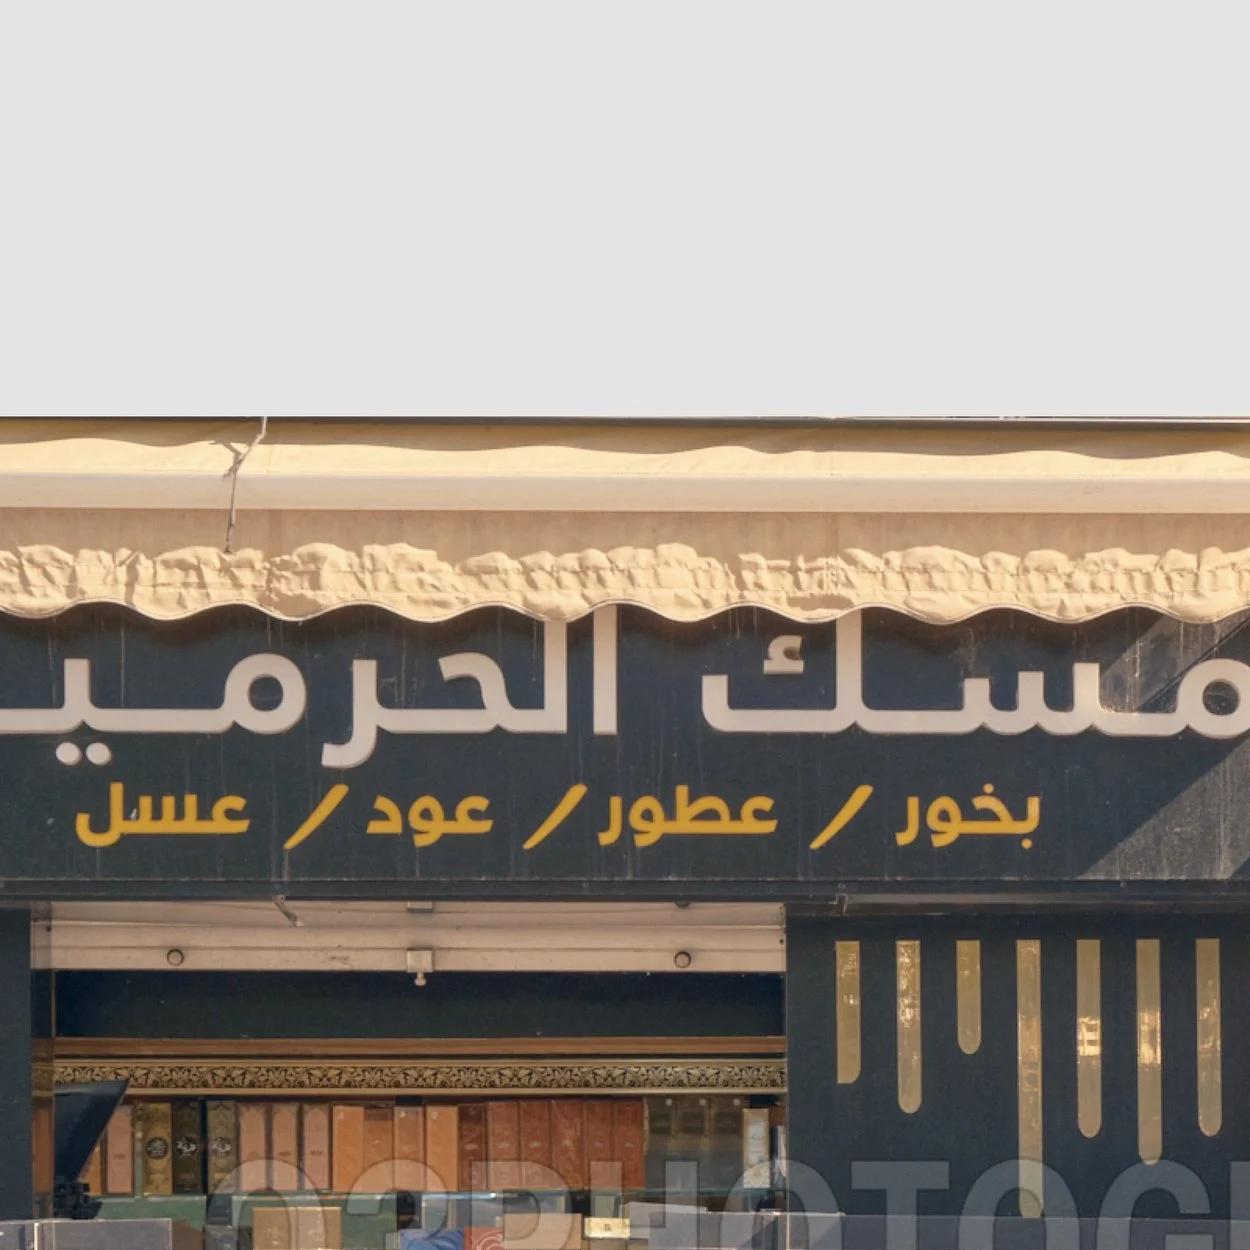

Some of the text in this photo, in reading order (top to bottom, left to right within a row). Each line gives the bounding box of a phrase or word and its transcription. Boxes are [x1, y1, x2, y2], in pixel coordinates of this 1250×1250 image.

[0, 604, 618, 769] الحرمي
[75, 782, 251, 848] عسل
[367, 795, 494, 848] عود
[597, 784, 778, 850] عطور
[895, 782, 1041, 850] بخور
